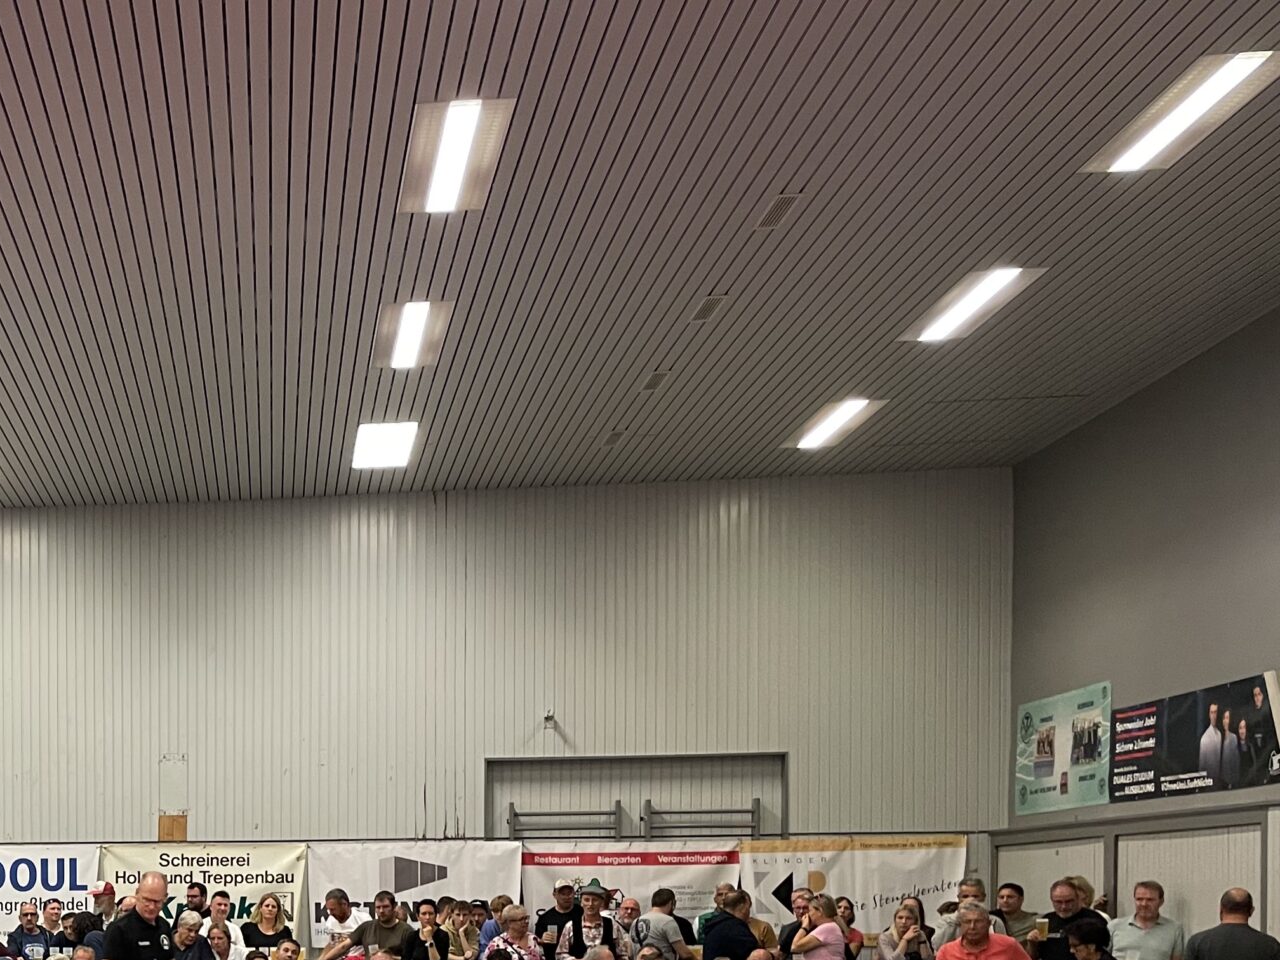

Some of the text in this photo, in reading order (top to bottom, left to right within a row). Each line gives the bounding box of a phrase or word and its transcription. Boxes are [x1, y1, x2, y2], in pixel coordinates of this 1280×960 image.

[158, 853, 250, 867] Schreinerei
[534, 854, 728, 865] Restaurant Biergarten Veranstaltungen
[115, 870, 141, 885] Hol
[199, 870, 295, 887] Treppenbau
